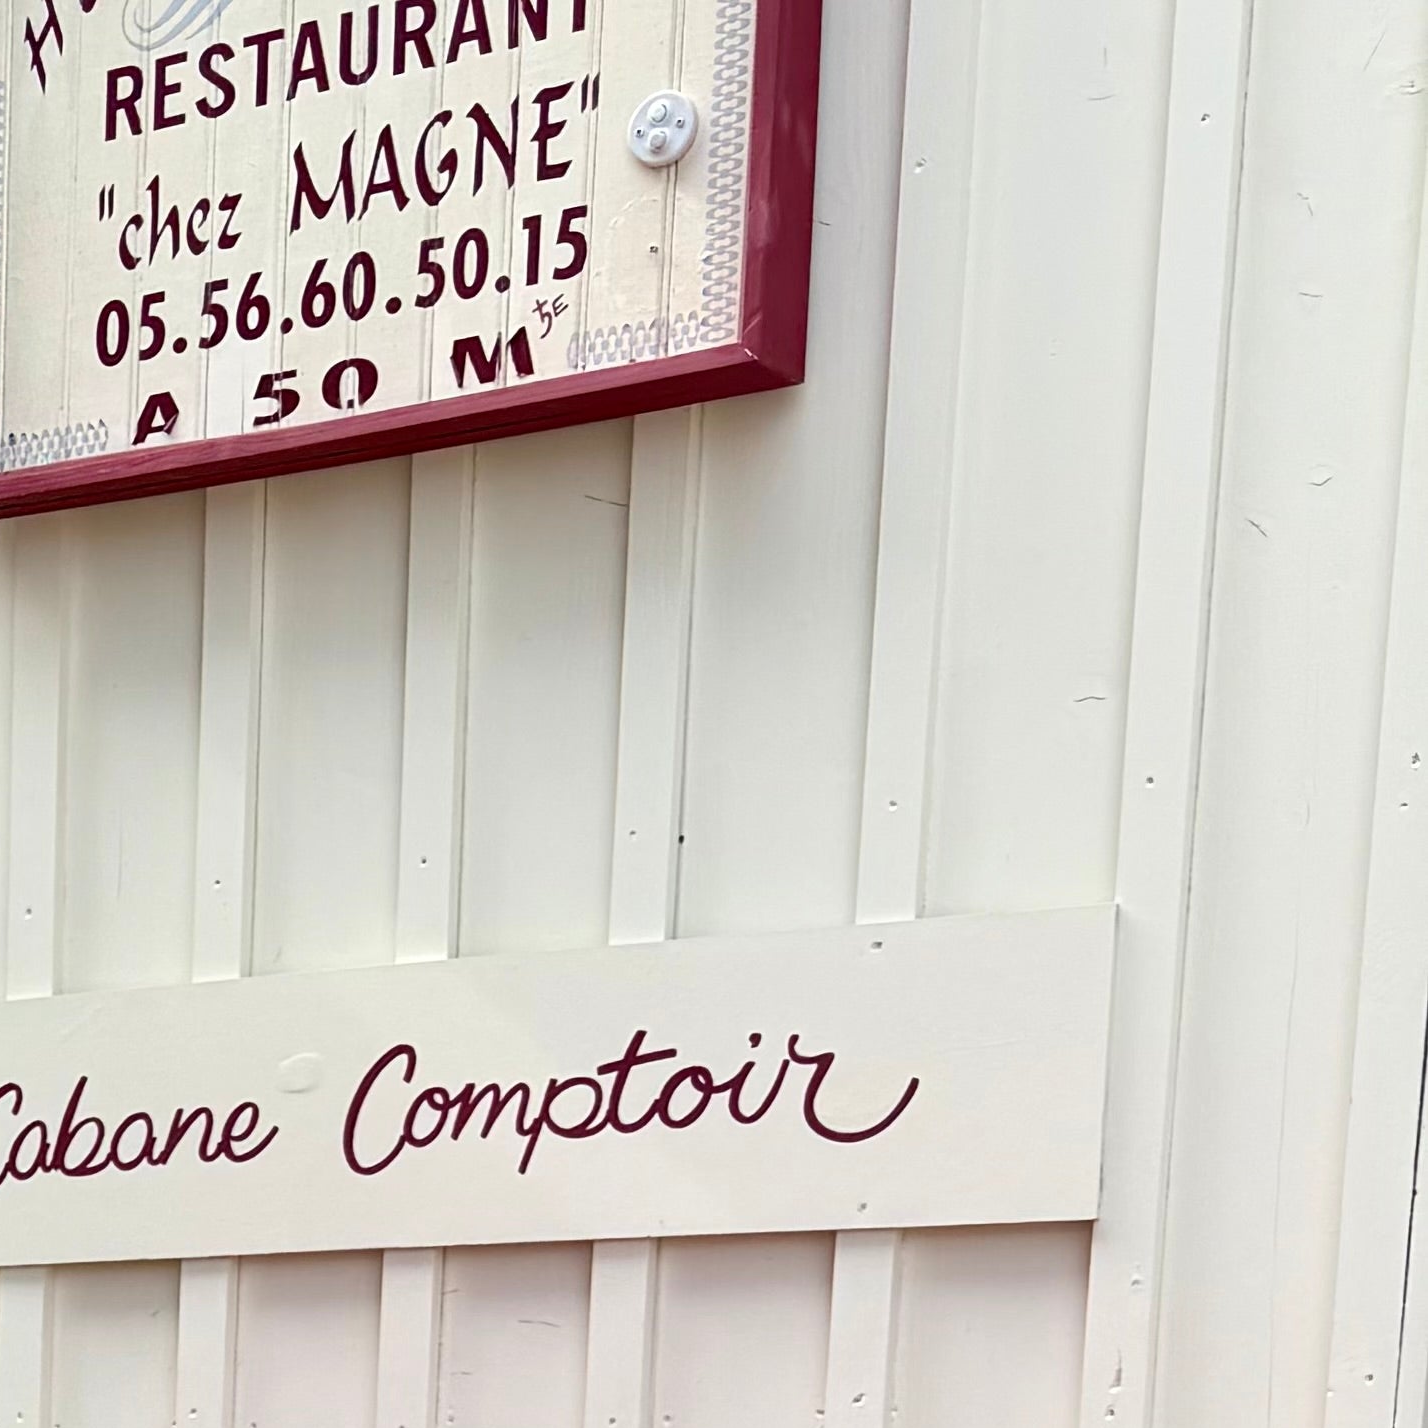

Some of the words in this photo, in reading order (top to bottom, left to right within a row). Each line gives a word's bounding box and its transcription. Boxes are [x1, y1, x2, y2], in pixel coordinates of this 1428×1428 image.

[99, 174, 243, 271] "chez
[289, 73, 601, 235] MAGNE"
[96, 204, 588, 367] 05.56.60.50.15
[131, 391, 180, 446] A
[252, 357, 379, 427] 50
[343, 1029, 921, 1177] Comptoir
